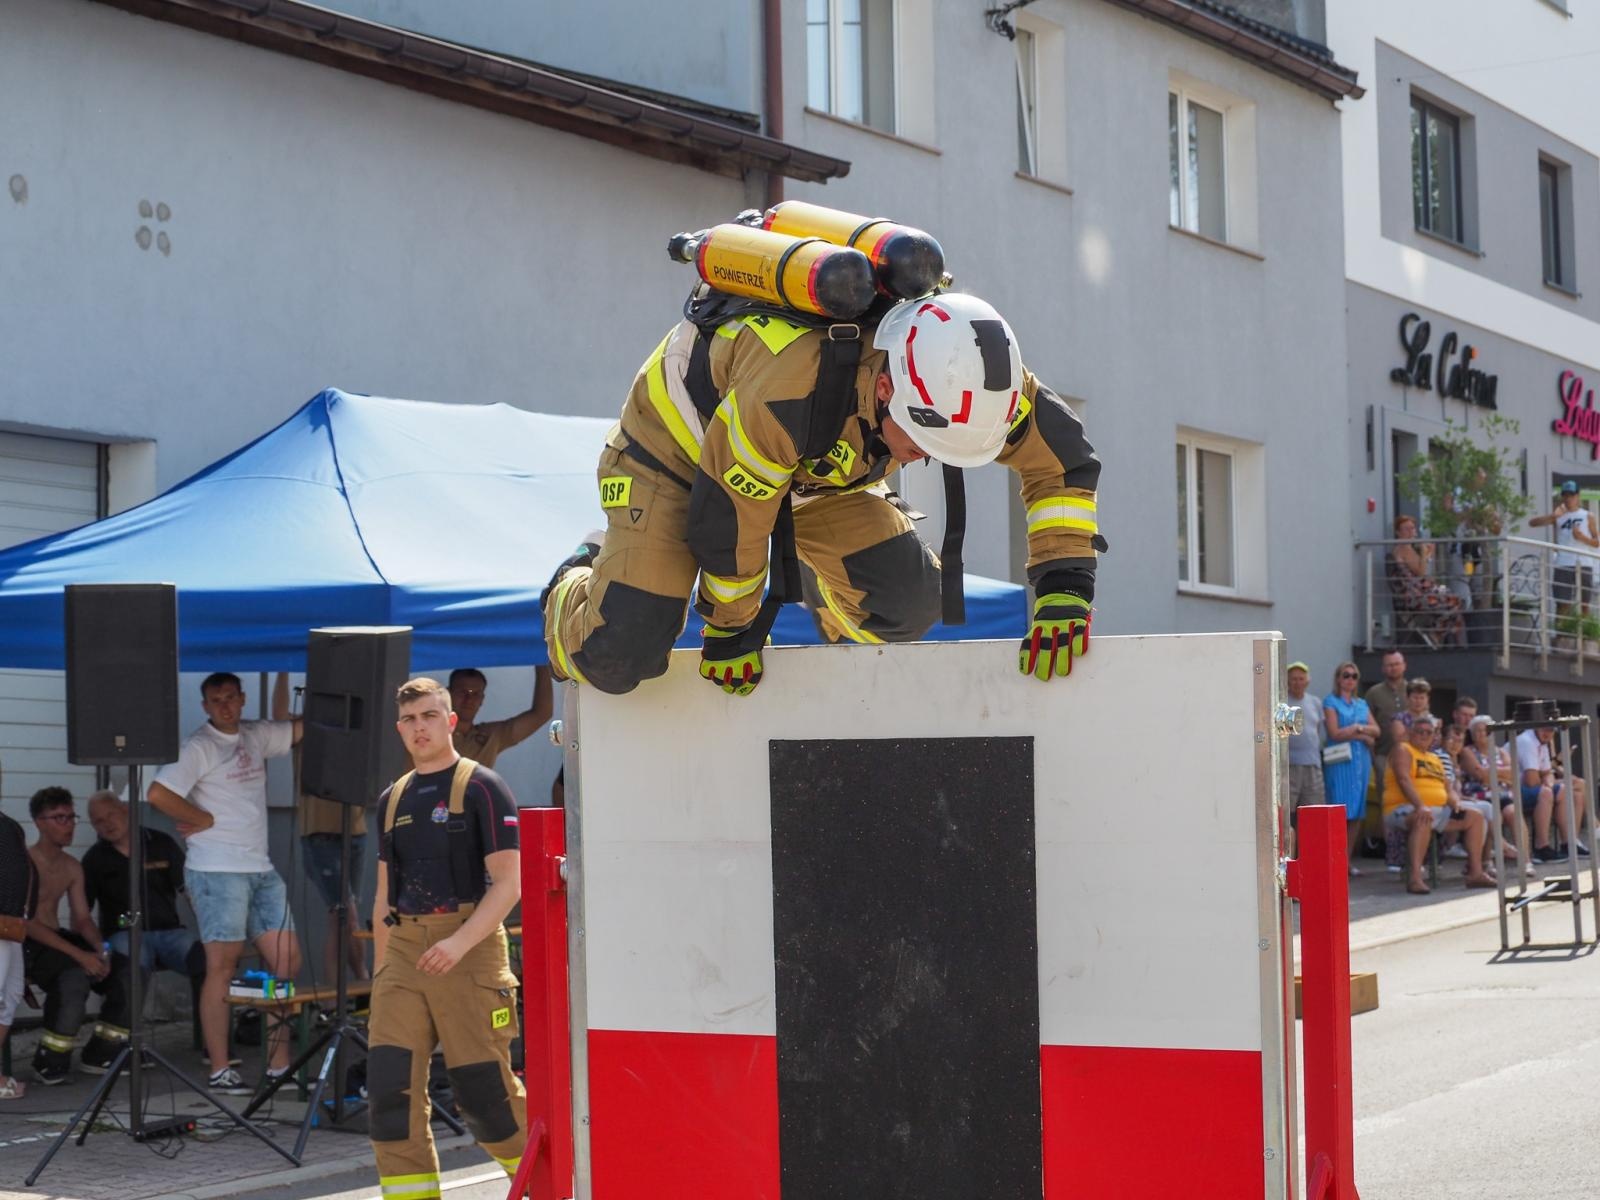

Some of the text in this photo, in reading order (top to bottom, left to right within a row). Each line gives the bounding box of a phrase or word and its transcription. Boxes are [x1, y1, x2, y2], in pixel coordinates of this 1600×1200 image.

[713, 265, 766, 290] POWIETRZE
[602, 482, 625, 502] OSP
[729, 473, 768, 497] OSP
